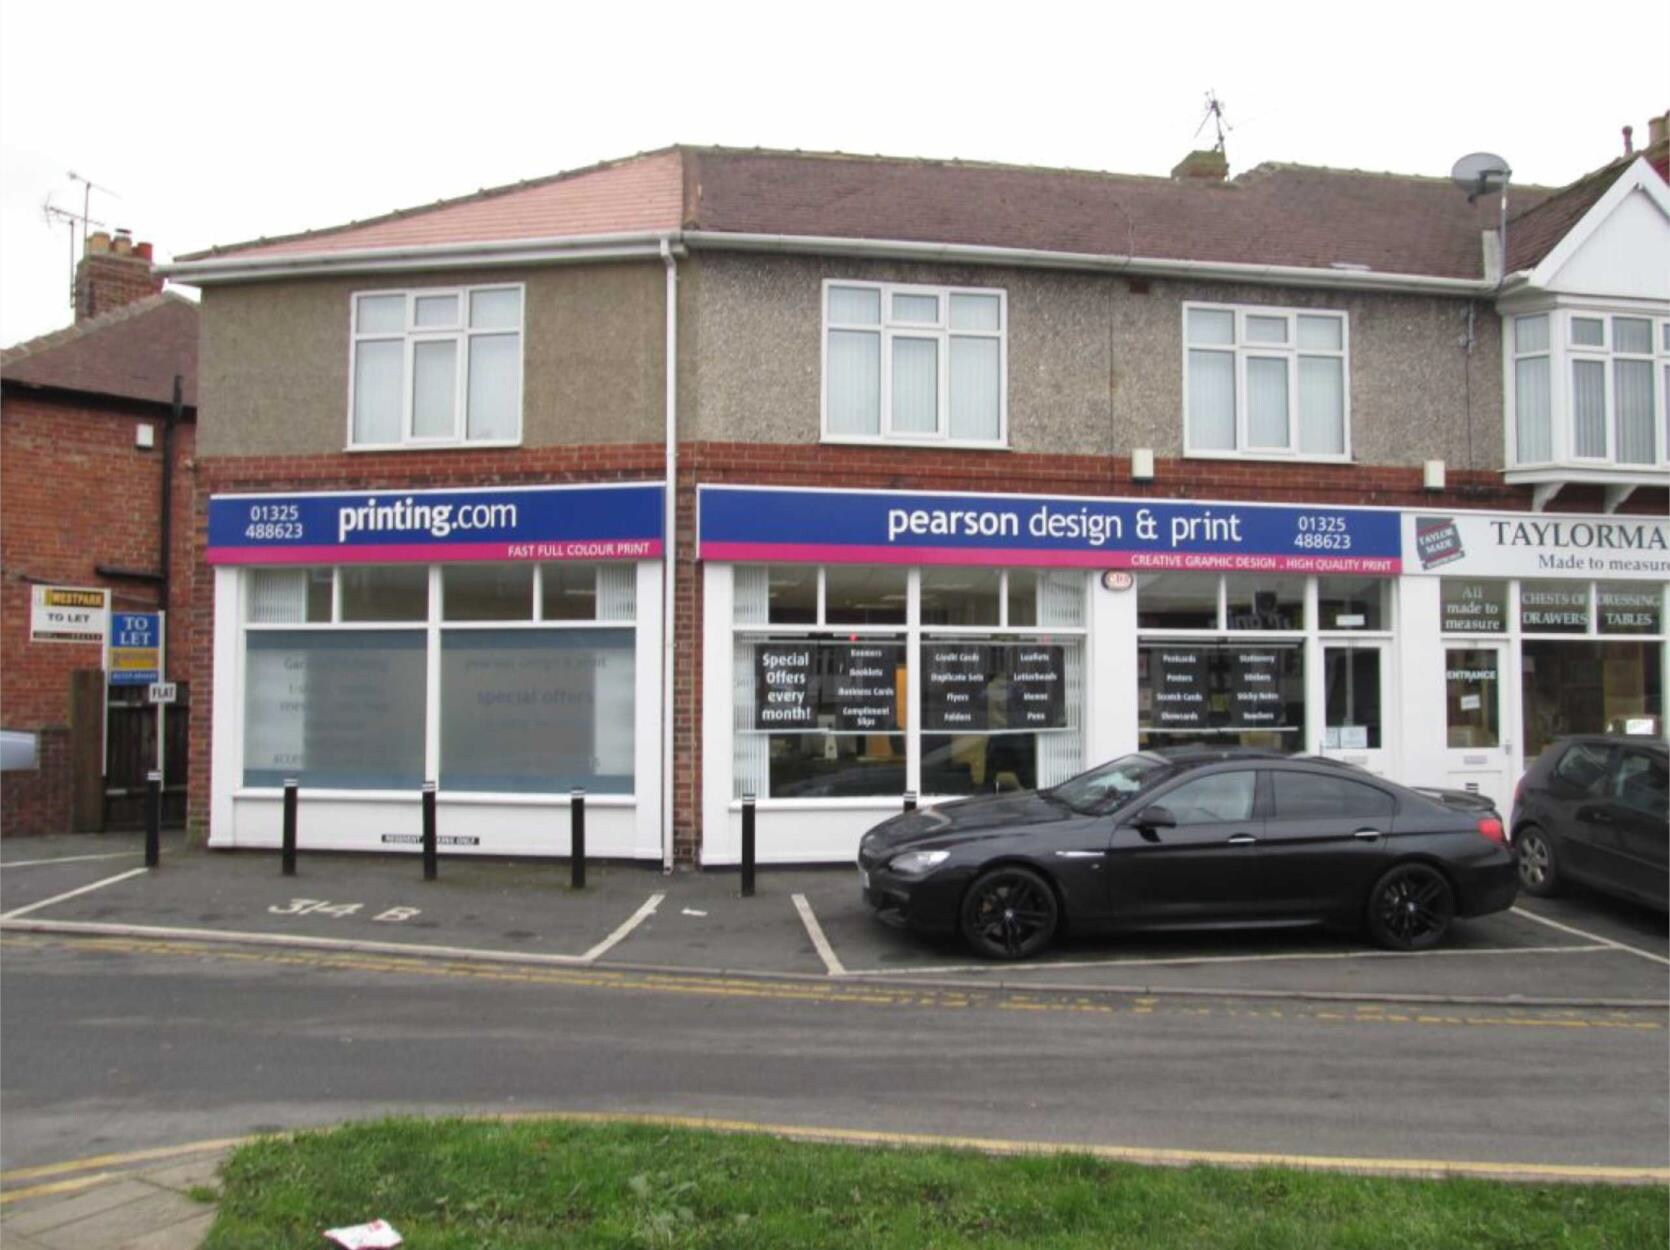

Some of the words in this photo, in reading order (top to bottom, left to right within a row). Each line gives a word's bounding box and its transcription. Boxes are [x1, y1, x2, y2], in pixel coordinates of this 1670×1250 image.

[250, 505, 299, 521] 01325
[338, 498, 518, 543] printing.com
[244, 521, 303, 539] 488623
[887, 508, 1019, 541] pearson
[1028, 508, 1123, 545] design
[1134, 509, 1158, 540] &
[1170, 509, 1242, 544] print
[1297, 516, 1347, 533] 01325
[1293, 532, 1352, 550] 488623
[507, 545, 535, 557] FAST
[537, 545, 563, 556] FULL
[566, 544, 613, 556] COLOUR
[616, 542, 650, 555] PRINT
[1131, 553, 1181, 566] CREATIVE
[1184, 556, 1233, 567] GRAPHIC
[1235, 557, 1276, 569] DESIGN
[1286, 560, 1314, 569] HIGH
[1315, 560, 1359, 571] QUALITY
[1362, 561, 1391, 571] PRINT
[1538, 554, 1585, 570] Made
[1588, 556, 1604, 570] to
[1462, 586, 1482, 599] All
[1522, 592, 1569, 605] CHESTS
[1447, 602, 1482, 614] made
[1484, 602, 1498, 614] to
[47, 612, 64, 622] TO
[67, 613, 90, 623] LET
[123, 616, 149, 631] TO
[1445, 618, 1500, 630] measure
[1522, 612, 1589, 625] DRAWERS
[1604, 612, 1653, 626] TABLES
[120, 631, 152, 646] LET
[762, 652, 809, 669] Special
[766, 671, 806, 684] Offers
[1446, 669, 1497, 680] ENTRANCE
[153, 686, 174, 698] FLAT
[767, 690, 805, 704] every
[762, 706, 811, 721] month!
[372, 905, 422, 922] B
